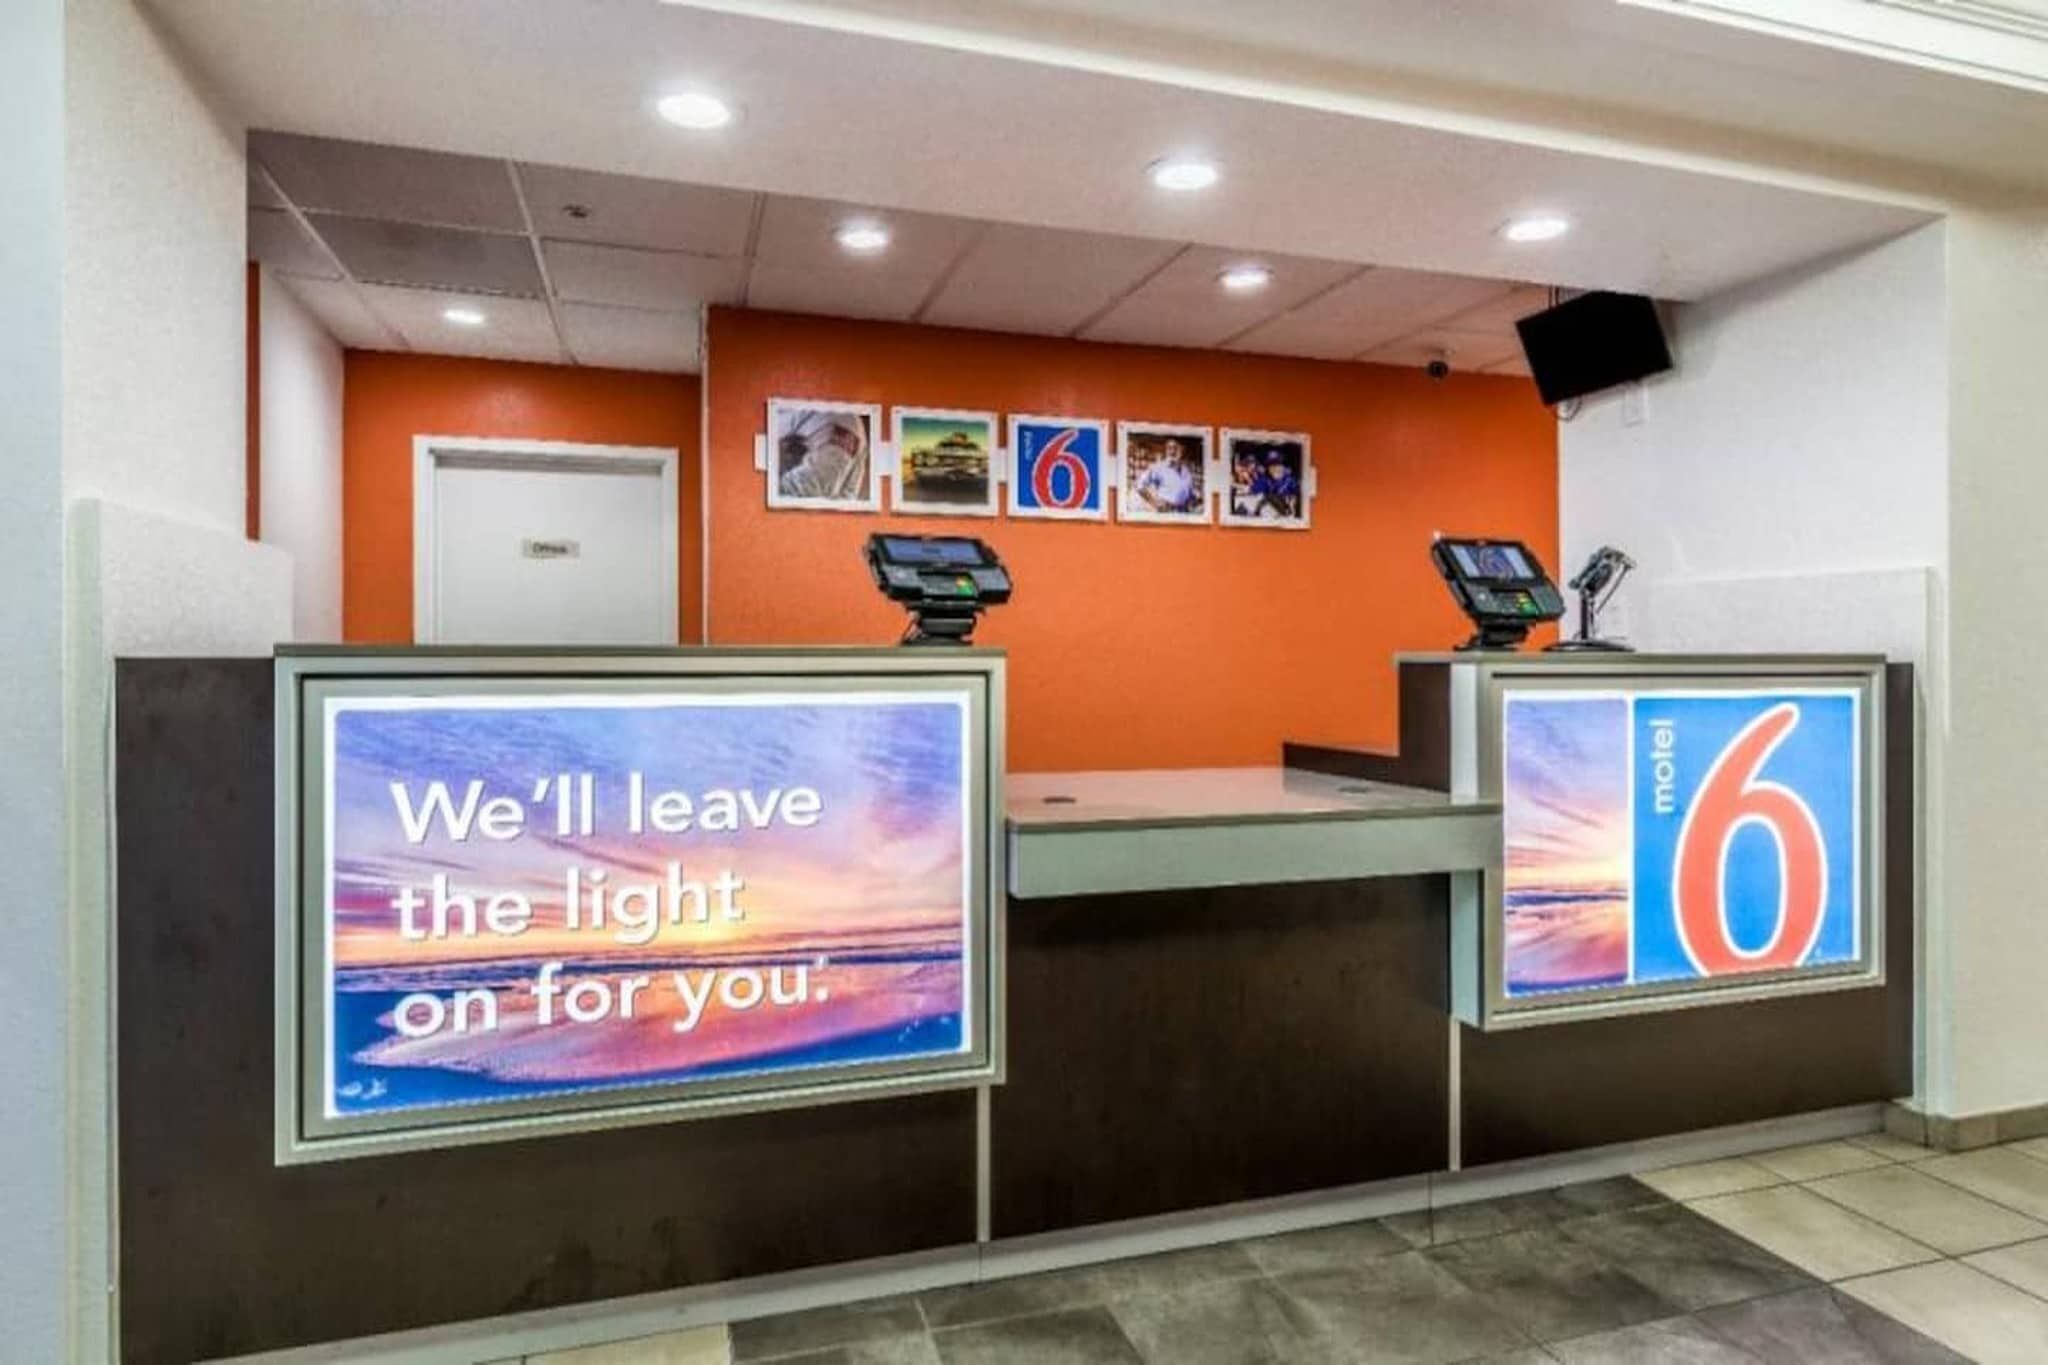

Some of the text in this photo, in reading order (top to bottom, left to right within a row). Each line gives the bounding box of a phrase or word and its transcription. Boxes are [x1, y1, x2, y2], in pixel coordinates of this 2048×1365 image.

[1032, 428, 1091, 508] 6
[391, 771, 822, 842] We'll leave
[1649, 702, 1829, 977] motel 6
[391, 861, 746, 944] the light
[394, 987, 499, 1038] on
[532, 962, 648, 1026] for
